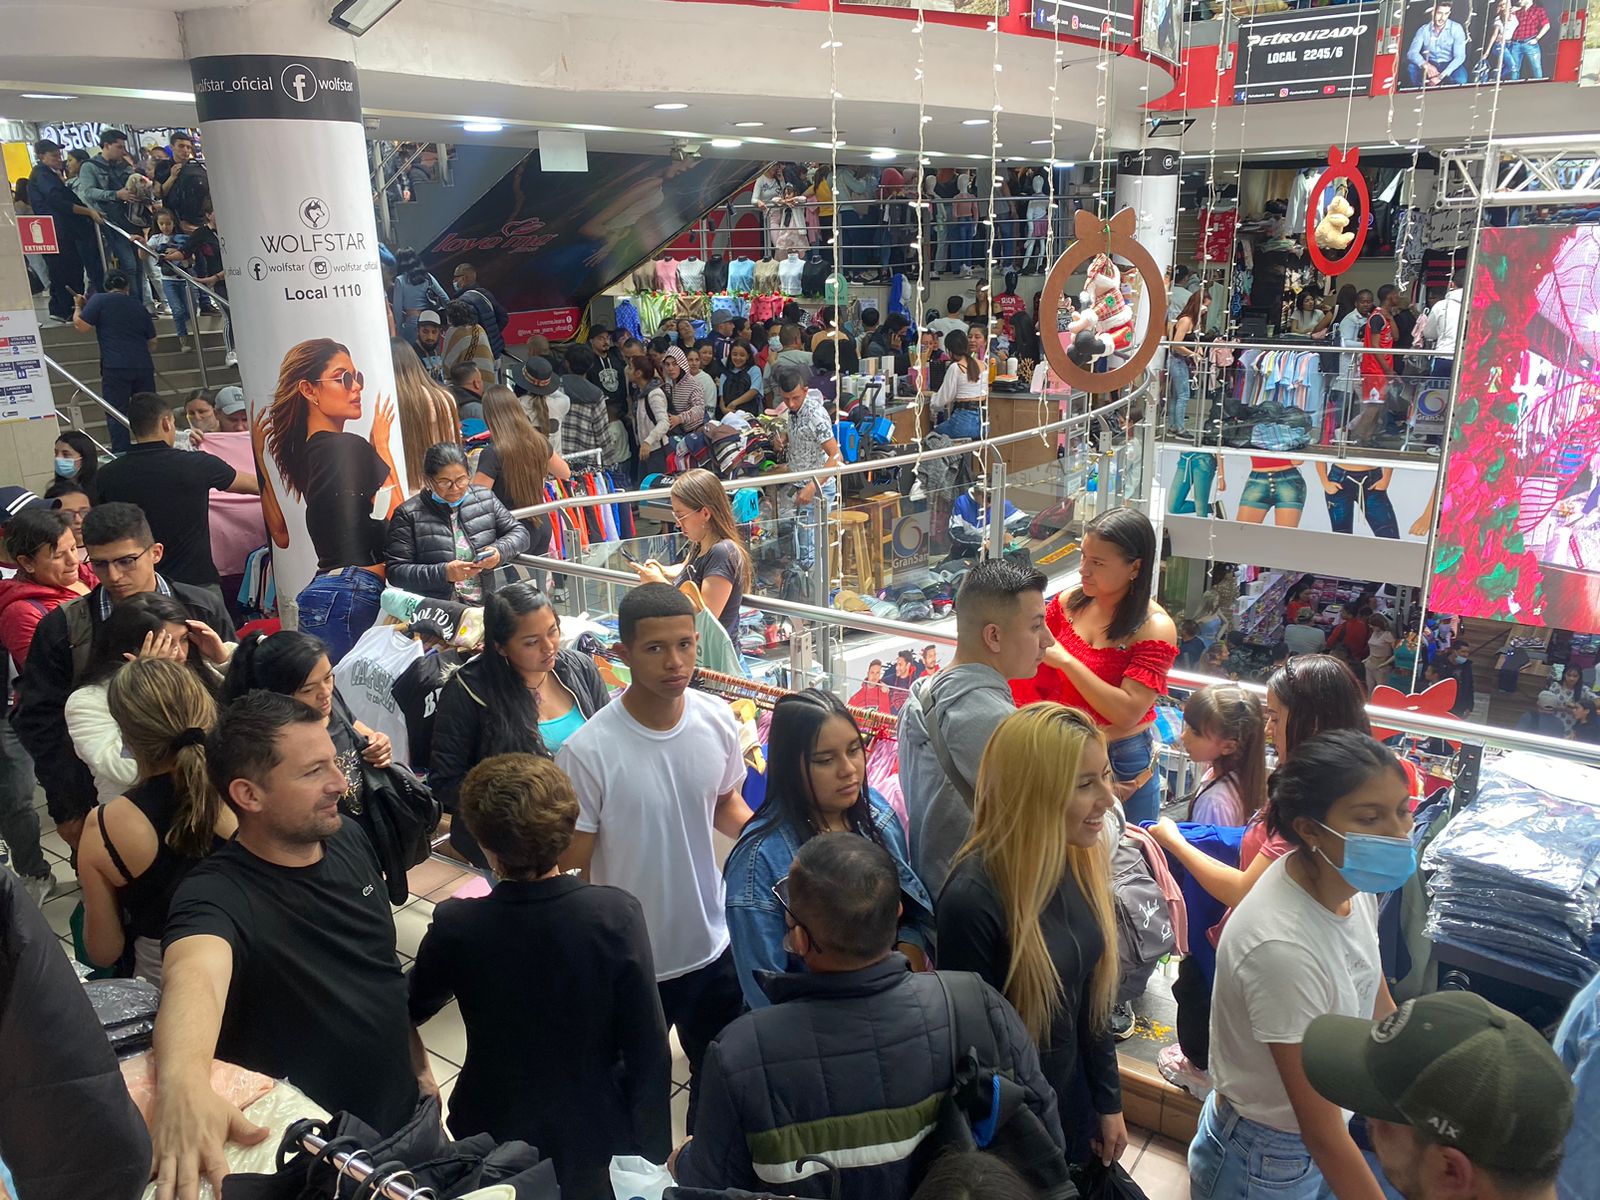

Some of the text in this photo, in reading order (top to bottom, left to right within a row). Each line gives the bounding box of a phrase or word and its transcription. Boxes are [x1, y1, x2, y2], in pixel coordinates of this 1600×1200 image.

[1267, 47, 1344, 64] LOCAL 2245/6
[318, 77, 353, 92] wolfstar
[260, 232, 366, 253] WOLFSTAR
[269, 262, 305, 273] wolfstar
[285, 283, 362, 301] Local 1110
[432, 607, 449, 626] TO
